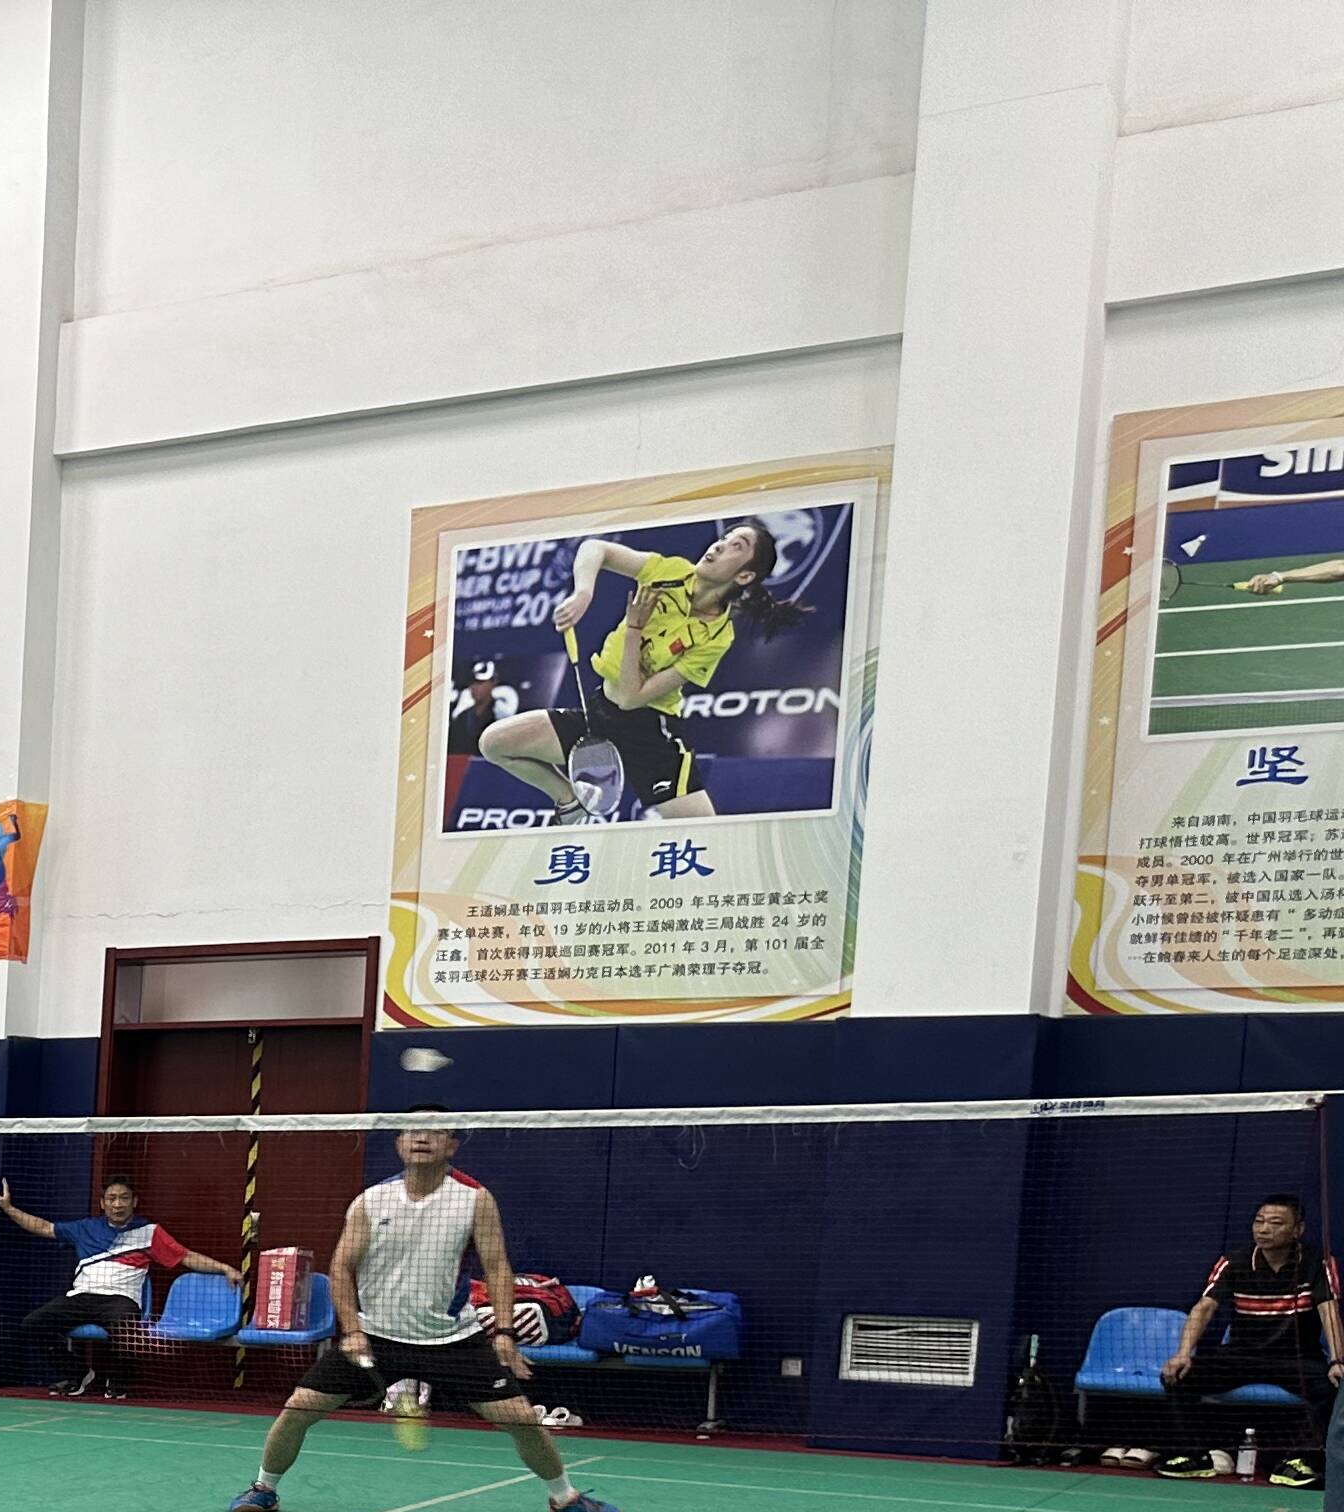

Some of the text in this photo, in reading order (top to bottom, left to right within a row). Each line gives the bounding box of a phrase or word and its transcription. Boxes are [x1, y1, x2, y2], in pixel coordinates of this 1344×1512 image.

[683, 686, 840, 719] ROTON
[1236, 746, 1308, 786] 坚
[1171, 808, 1344, 829] 来自湖南，中国羽毛球运
[534, 838, 715, 885] 勇 敢
